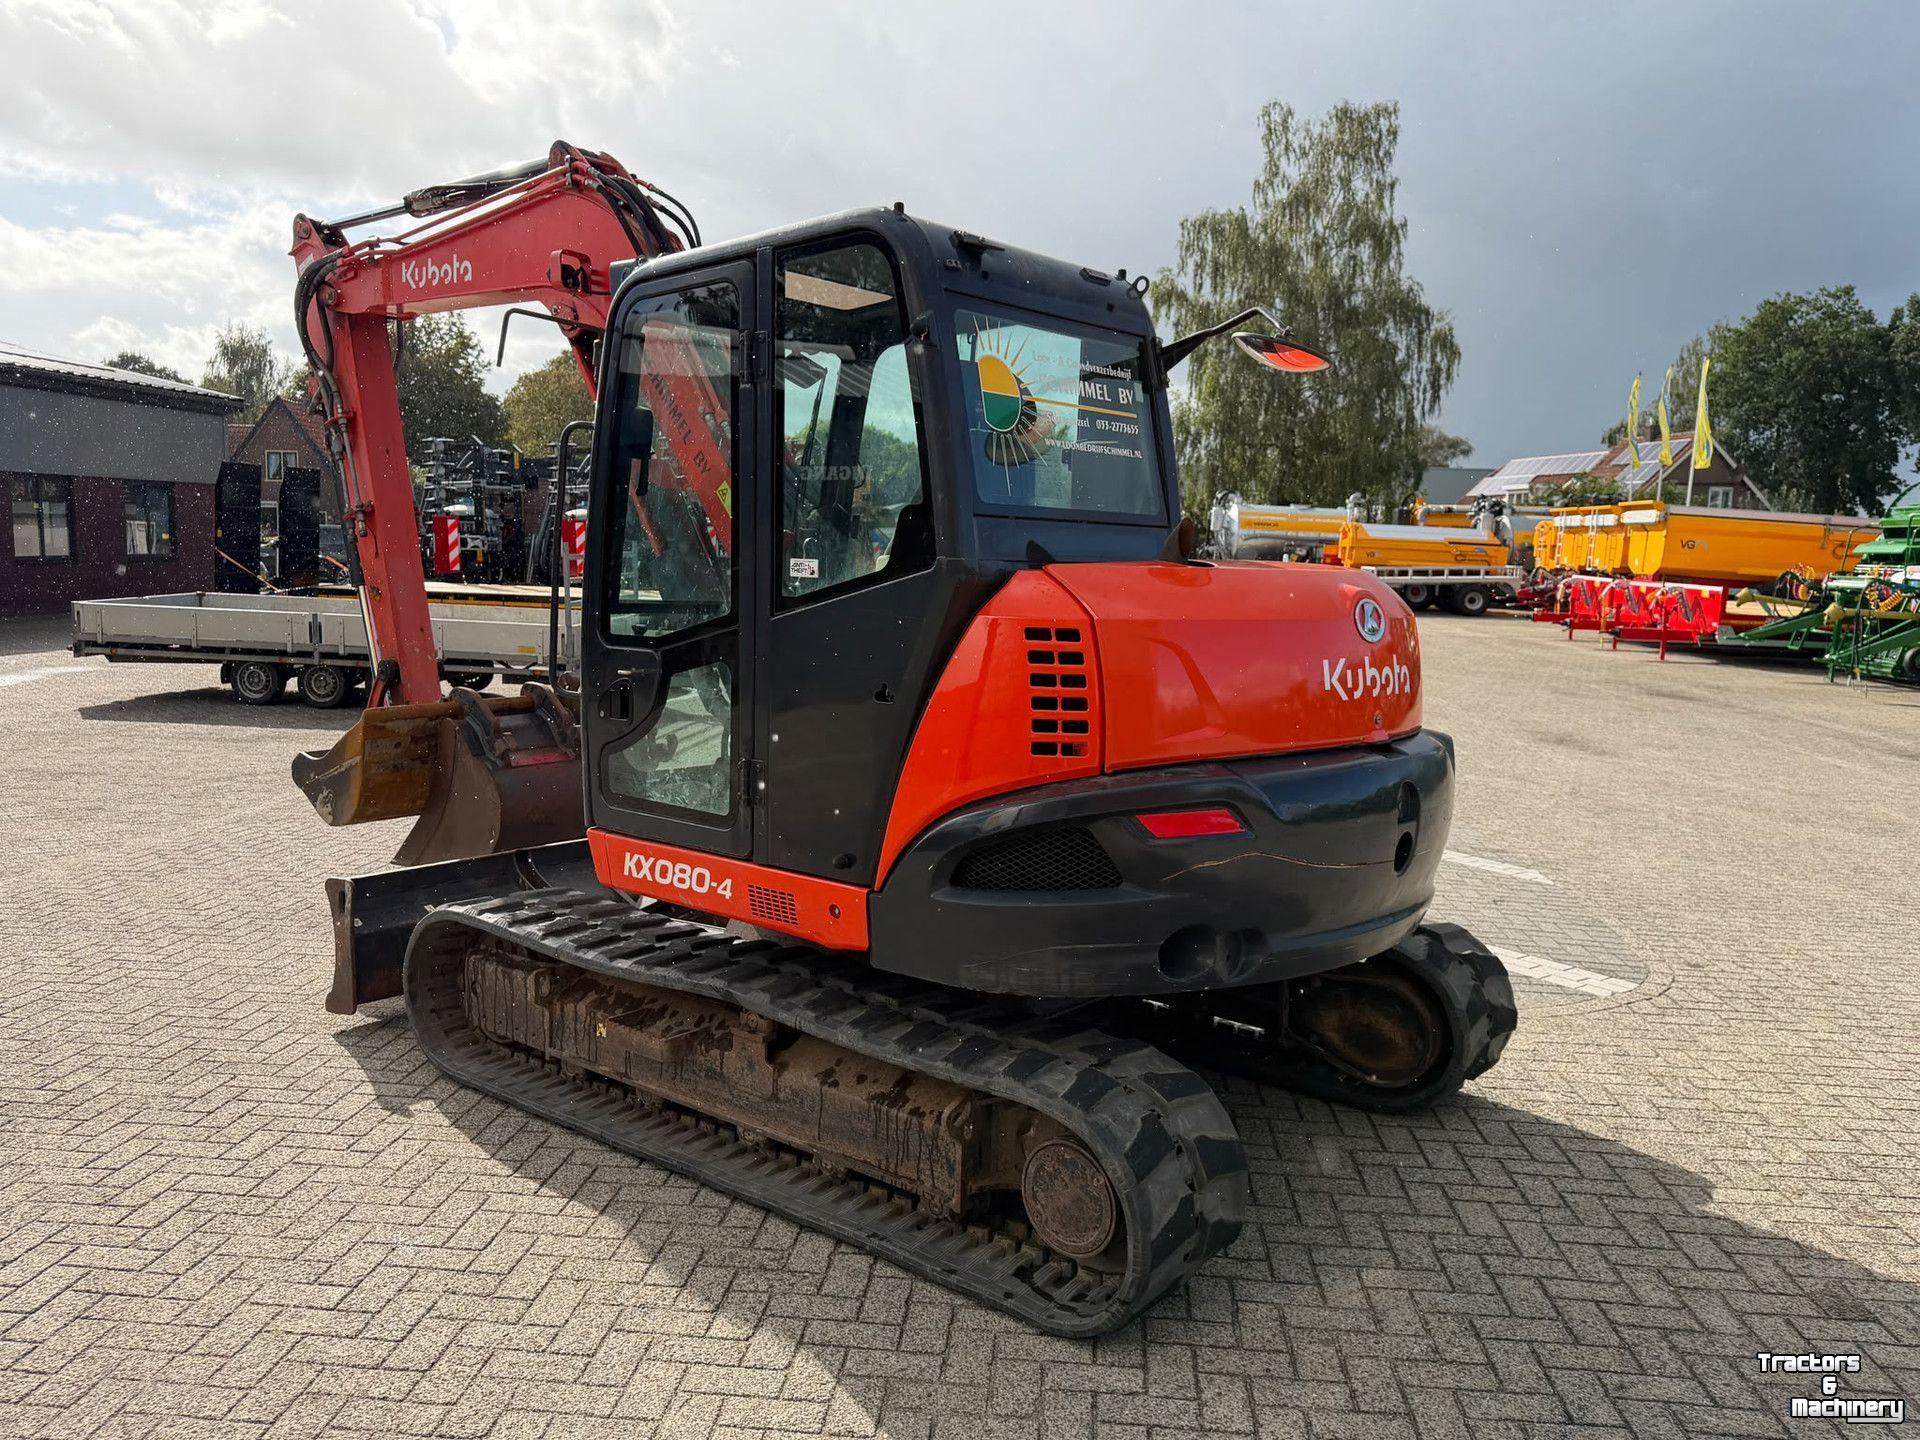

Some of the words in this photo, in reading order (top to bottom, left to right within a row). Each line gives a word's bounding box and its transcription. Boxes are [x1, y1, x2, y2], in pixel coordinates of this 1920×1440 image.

[402, 254, 473, 290] Kubota
[1118, 387, 1133, 405] BV
[1680, 539, 1696, 549] VG
[1323, 654, 1411, 701] Kubota
[624, 852, 733, 900] KX080-4
